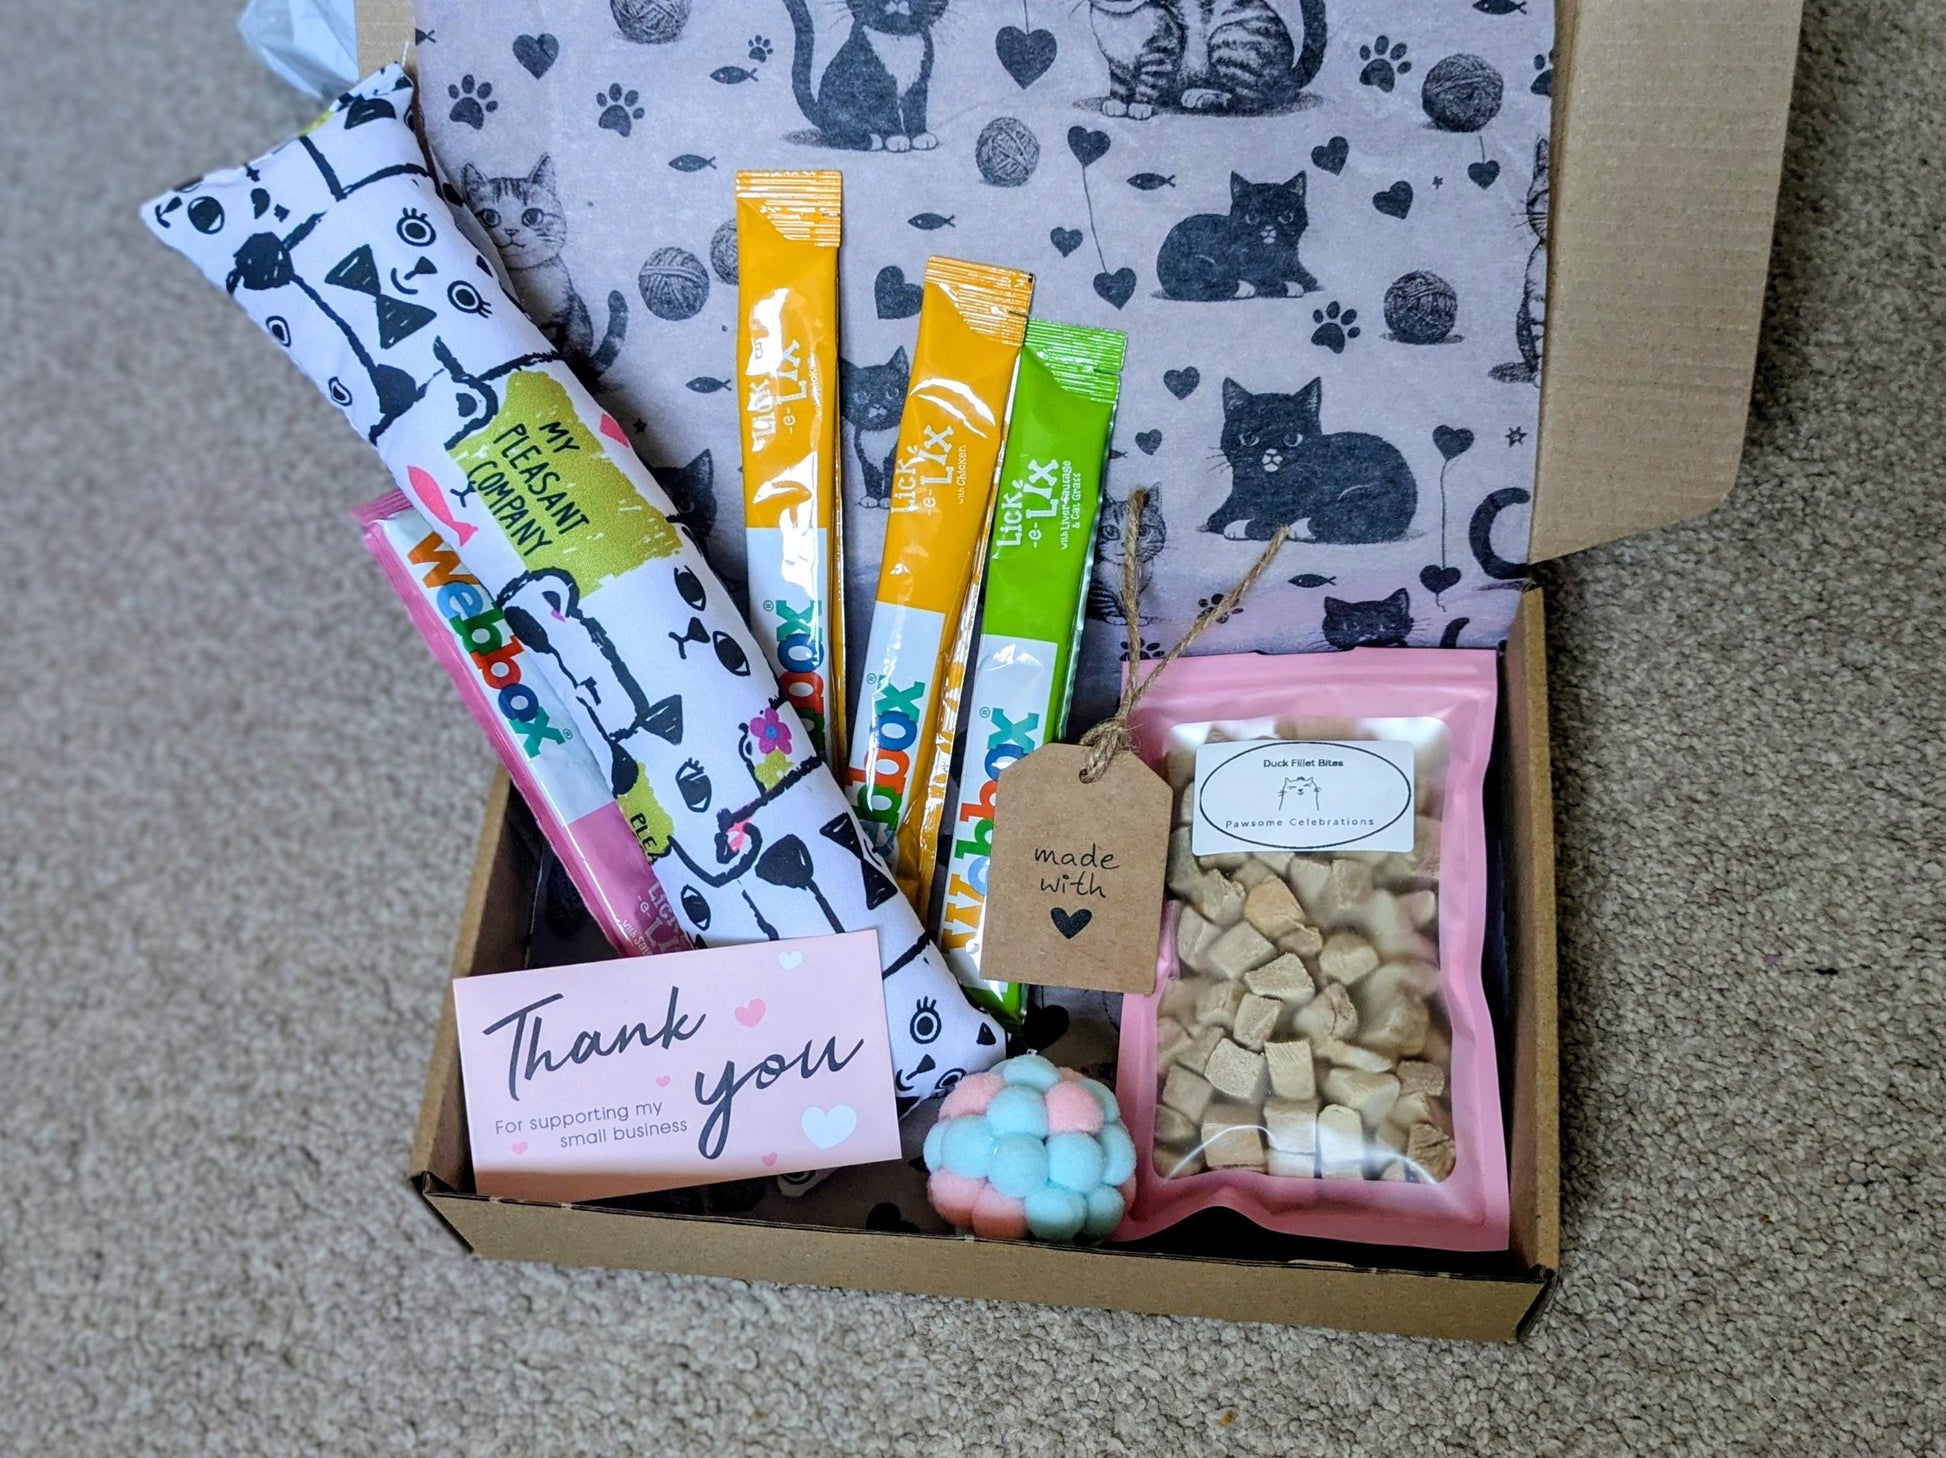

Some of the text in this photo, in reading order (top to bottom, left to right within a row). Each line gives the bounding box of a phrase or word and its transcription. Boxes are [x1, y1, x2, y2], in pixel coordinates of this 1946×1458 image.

[538, 421, 581, 454] MY
[493, 423, 591, 535] PLEASANT
[957, 444, 967, 484] Chicken
[466, 460, 554, 558] COMPANY
[1060, 459, 1072, 550] with Liver Sausage
[1071, 472, 1082, 530] & Cat Grass
[407, 530, 566, 759] Webbox
[845, 674, 926, 835] bbox
[1263, 758, 1344, 768] Duck Fillet Bites
[1225, 816, 1375, 829] Pawsome Celebrations
[1034, 843, 1120, 870] made
[1040, 871, 1107, 898] with
[644, 915, 684, 954] Li
[482, 985, 707, 1101] Thank
[694, 1034, 865, 1160] you
[495, 1101, 664, 1135] For supporting my
[559, 1117, 688, 1149] small business
